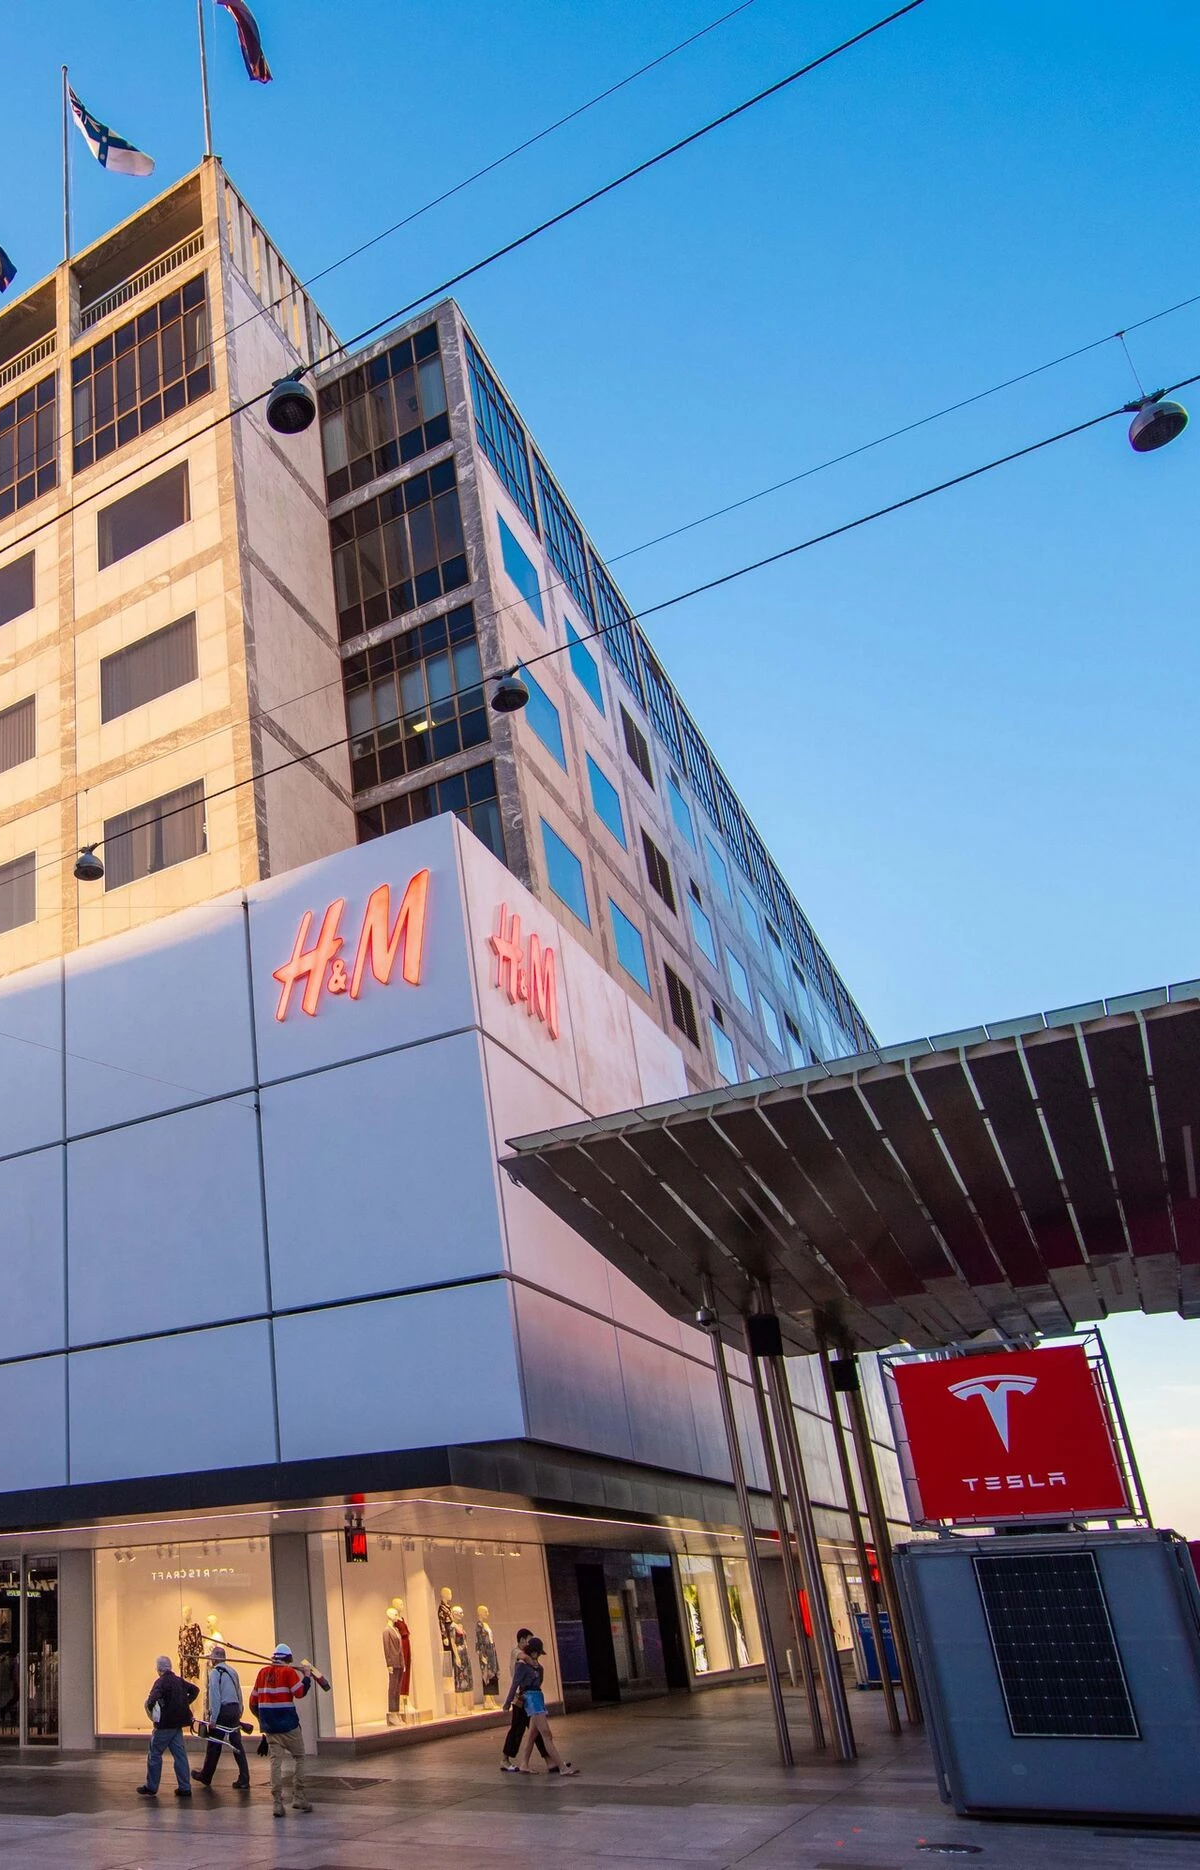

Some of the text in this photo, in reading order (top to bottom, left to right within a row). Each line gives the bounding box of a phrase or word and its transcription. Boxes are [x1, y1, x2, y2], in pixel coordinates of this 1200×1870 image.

[272, 867, 430, 1023] H&M
[488, 902, 559, 1042] H&M
[961, 1472, 1067, 1492] TESLA
